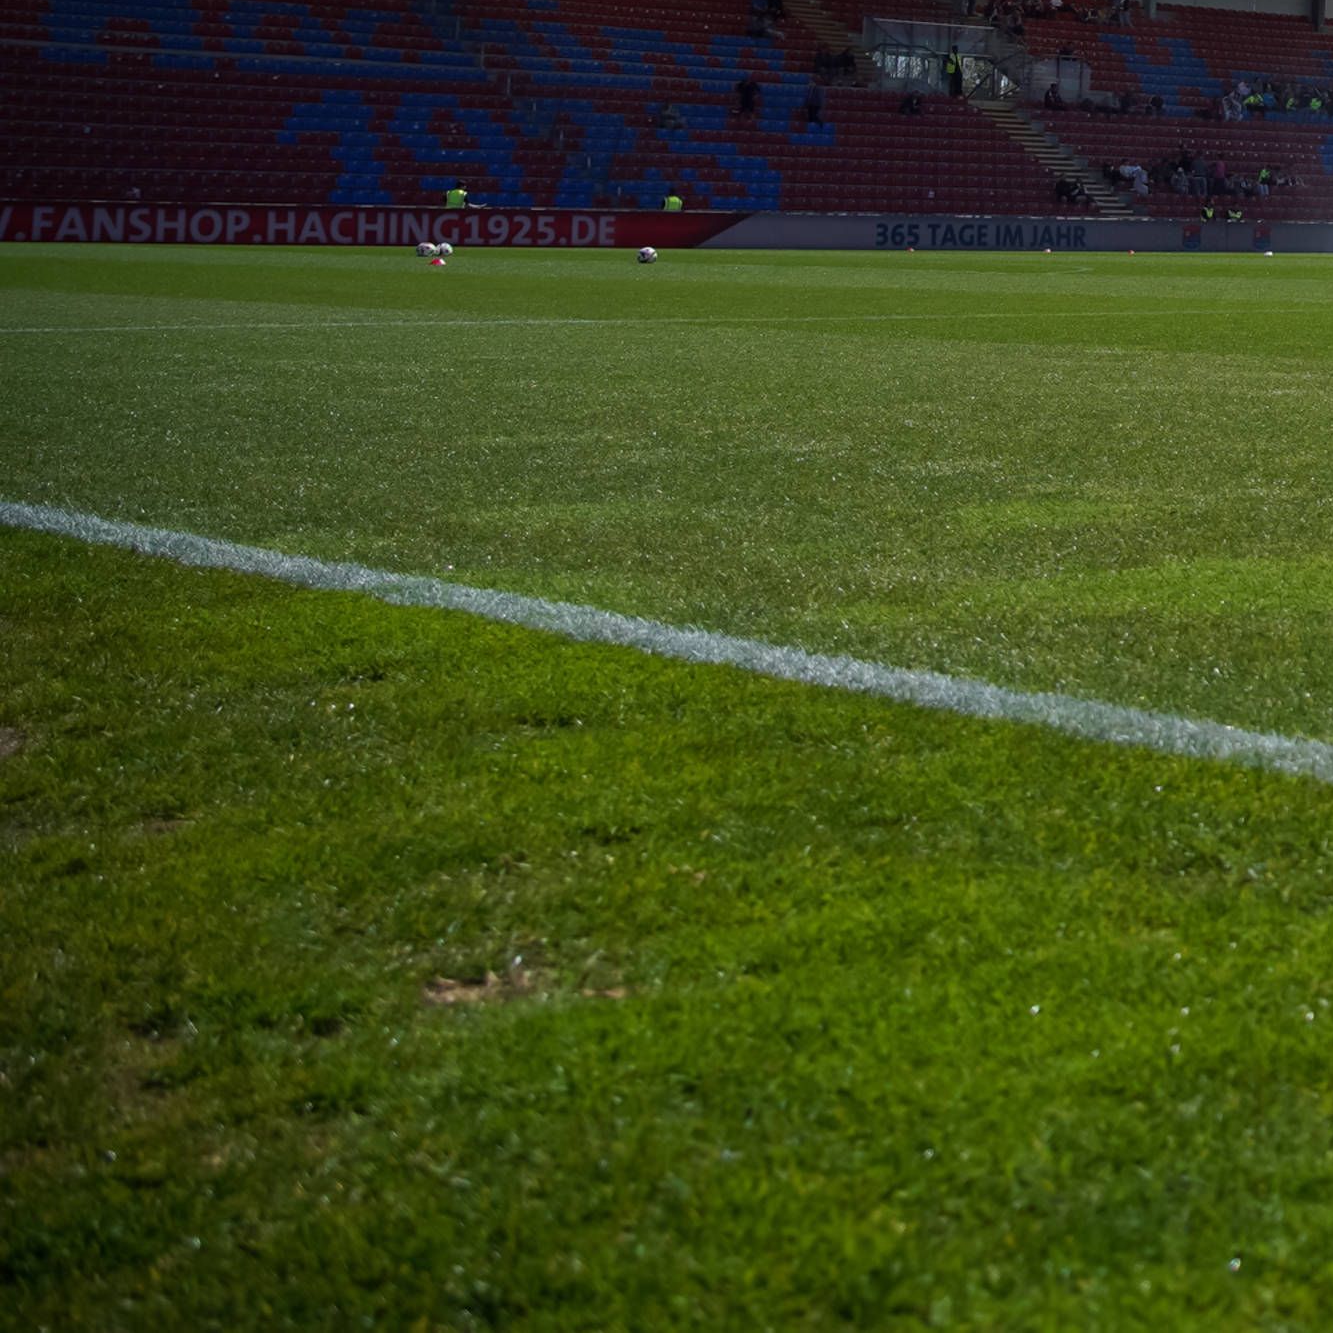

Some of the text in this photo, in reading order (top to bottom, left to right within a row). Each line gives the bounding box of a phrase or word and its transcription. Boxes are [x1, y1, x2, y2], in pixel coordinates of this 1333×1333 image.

[875, 223, 1087, 248] 365 TAGE IM JAHR
